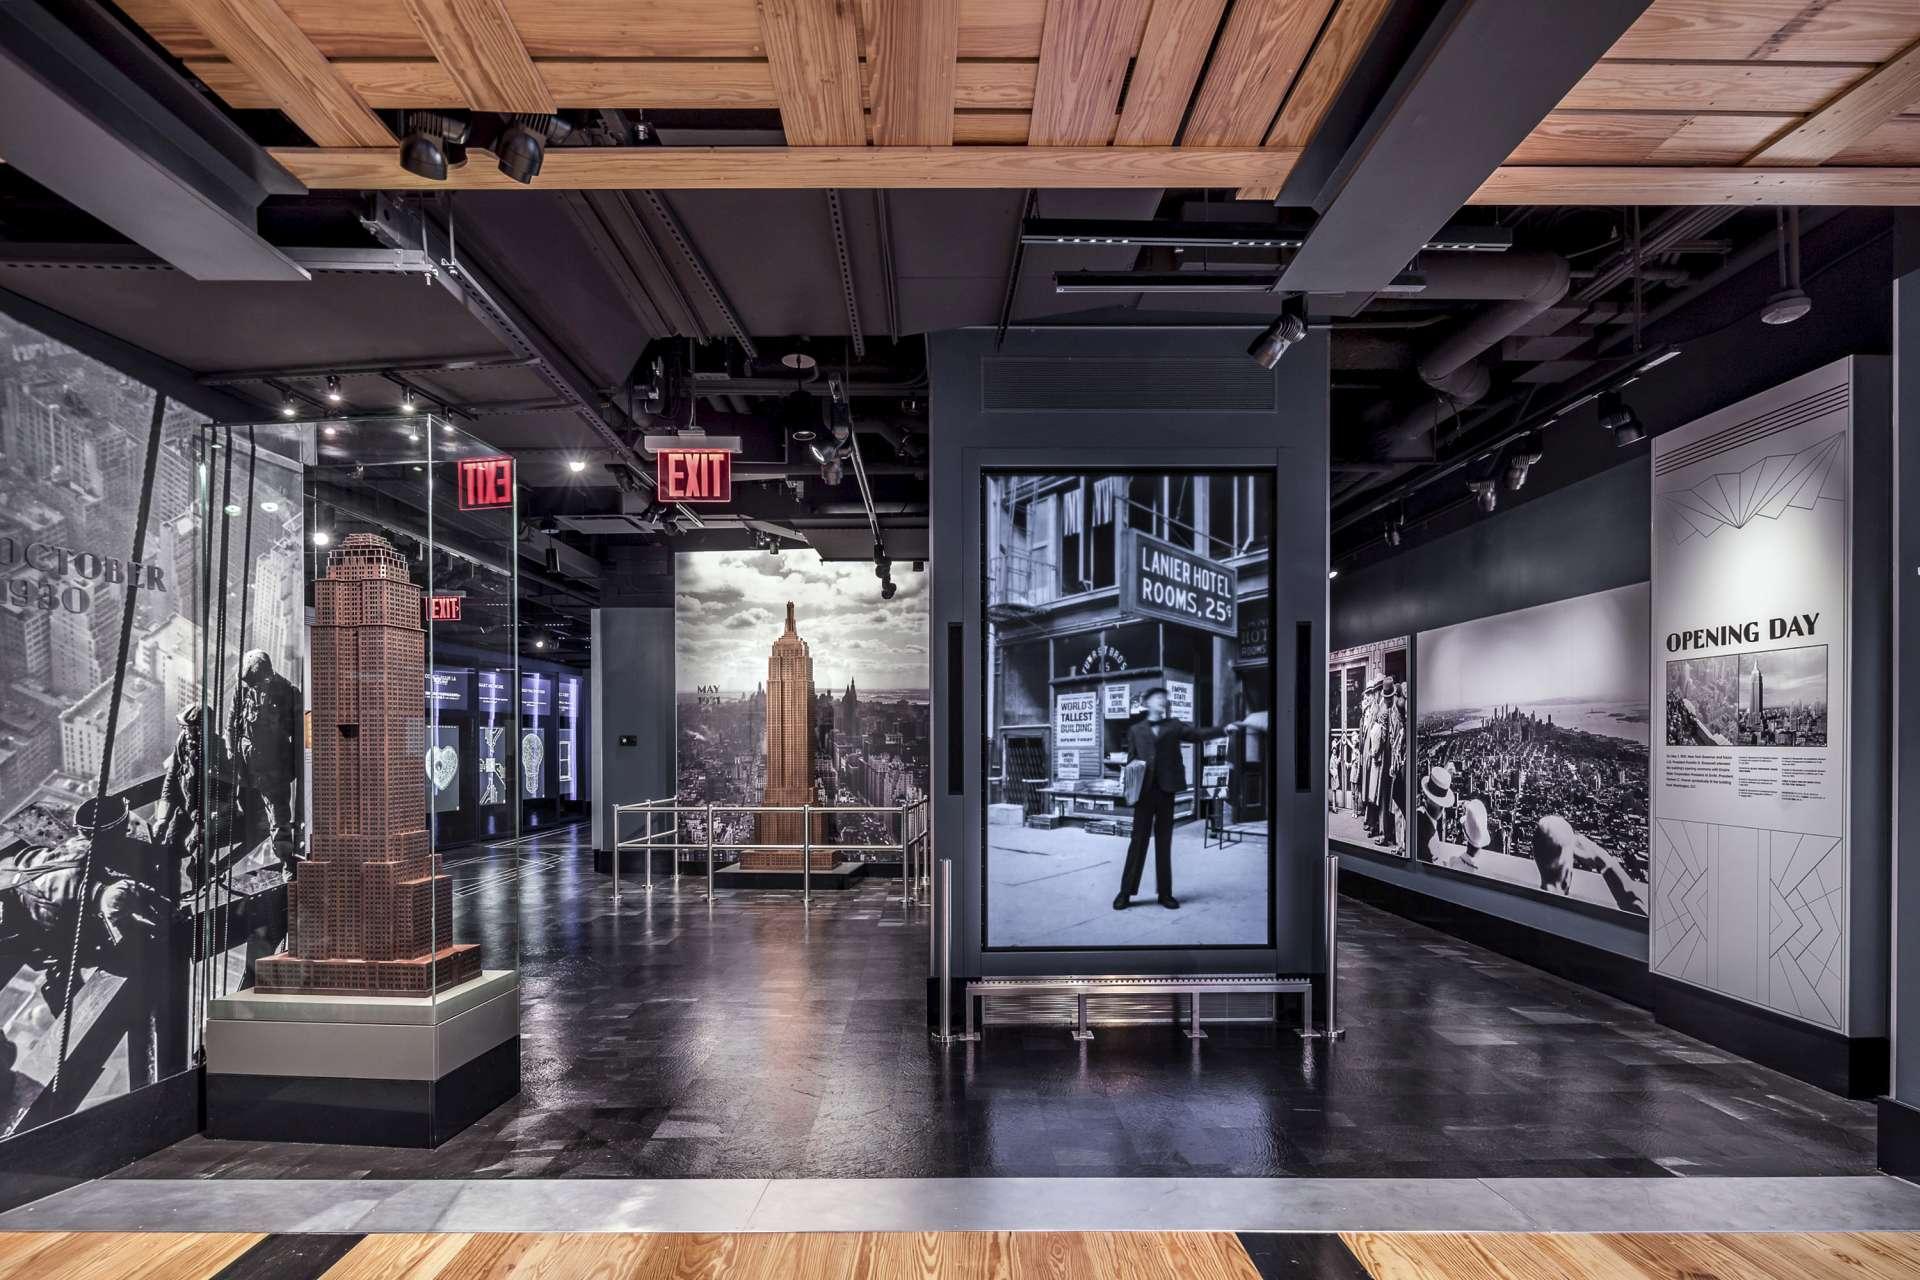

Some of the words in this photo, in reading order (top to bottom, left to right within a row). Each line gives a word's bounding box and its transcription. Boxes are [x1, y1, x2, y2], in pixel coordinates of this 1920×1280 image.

[668, 453, 725, 498] EXIT
[0, 537, 167, 593] OCTOBER
[1142, 546, 1191, 585] LANIER
[1193, 565, 1232, 598] HOTEL
[0, 577, 91, 614] 1930
[431, 598, 458, 619] EXIT
[1142, 577, 1202, 618] ROOMS,
[1666, 621, 1760, 652] OPENING
[1769, 612, 1820, 640] DAY
[697, 685, 720, 694] MAY
[1060, 700, 1094, 711] WORLD'S
[1060, 723, 1093, 734] BUILDING
[1061, 712, 1094, 722] TALLEST
